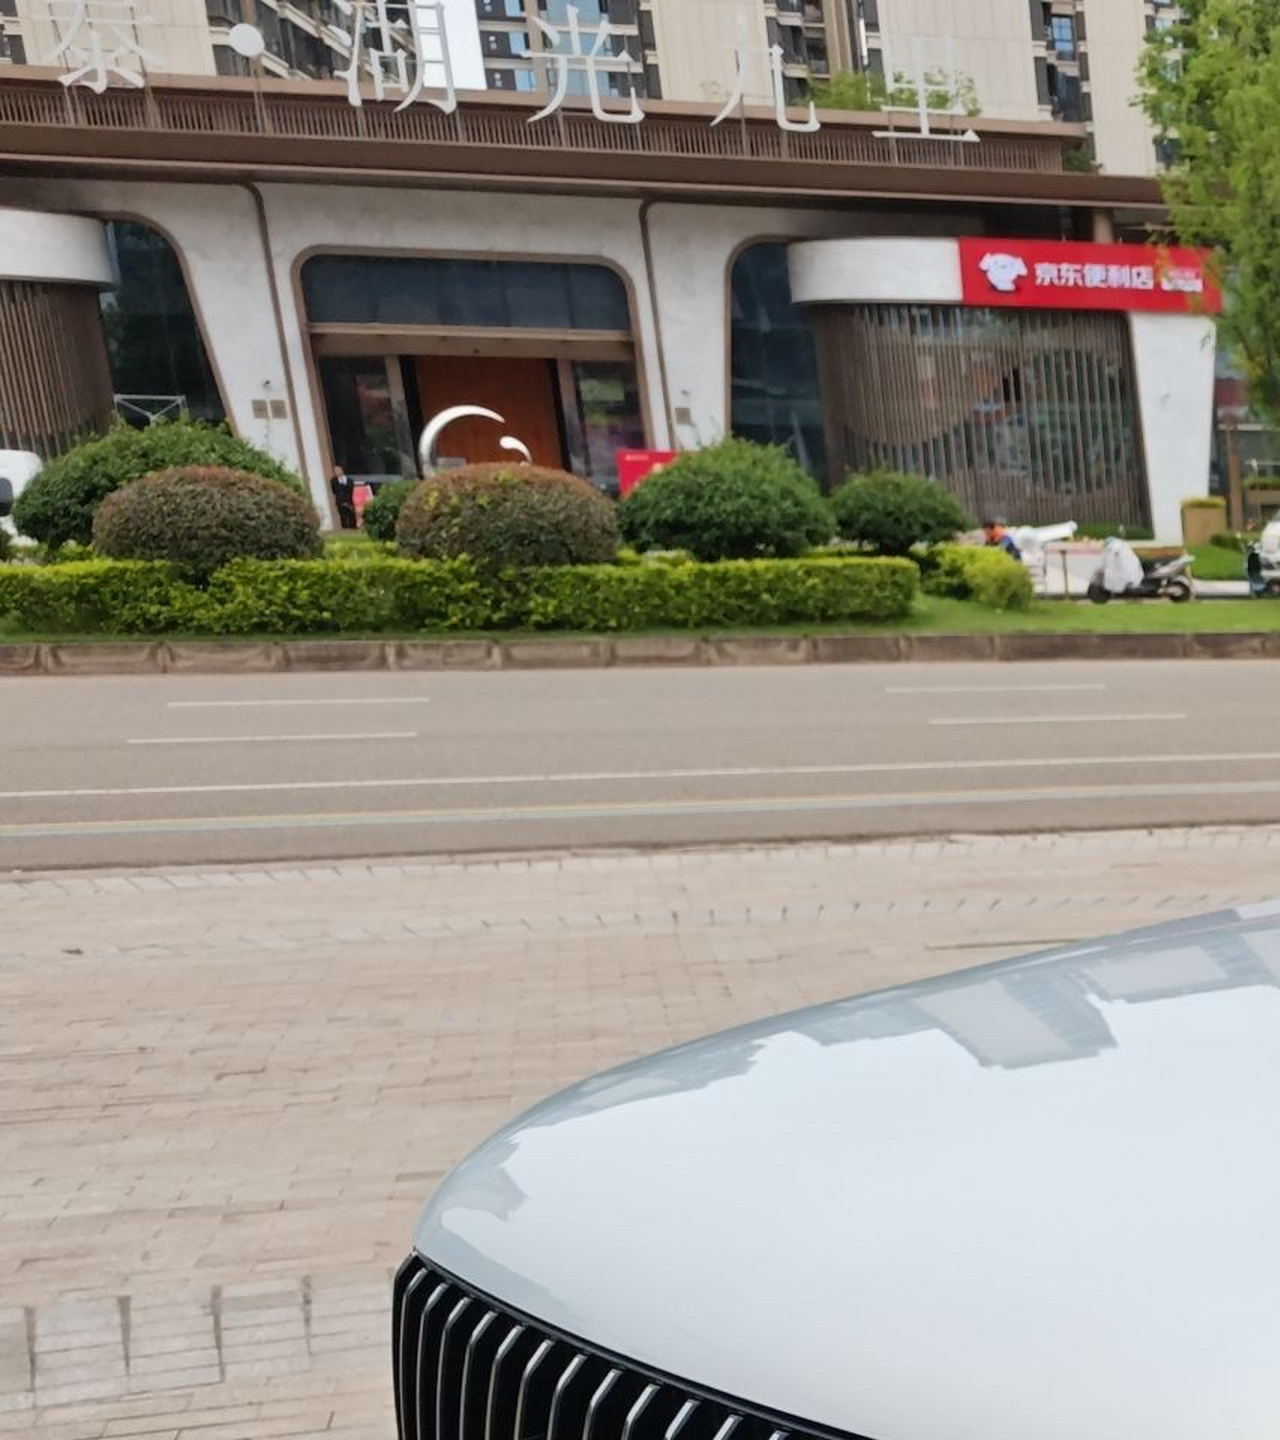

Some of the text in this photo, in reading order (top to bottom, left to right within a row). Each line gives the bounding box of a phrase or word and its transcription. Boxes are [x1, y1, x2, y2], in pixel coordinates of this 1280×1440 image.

[1034, 262, 1154, 290] 京东便利店
